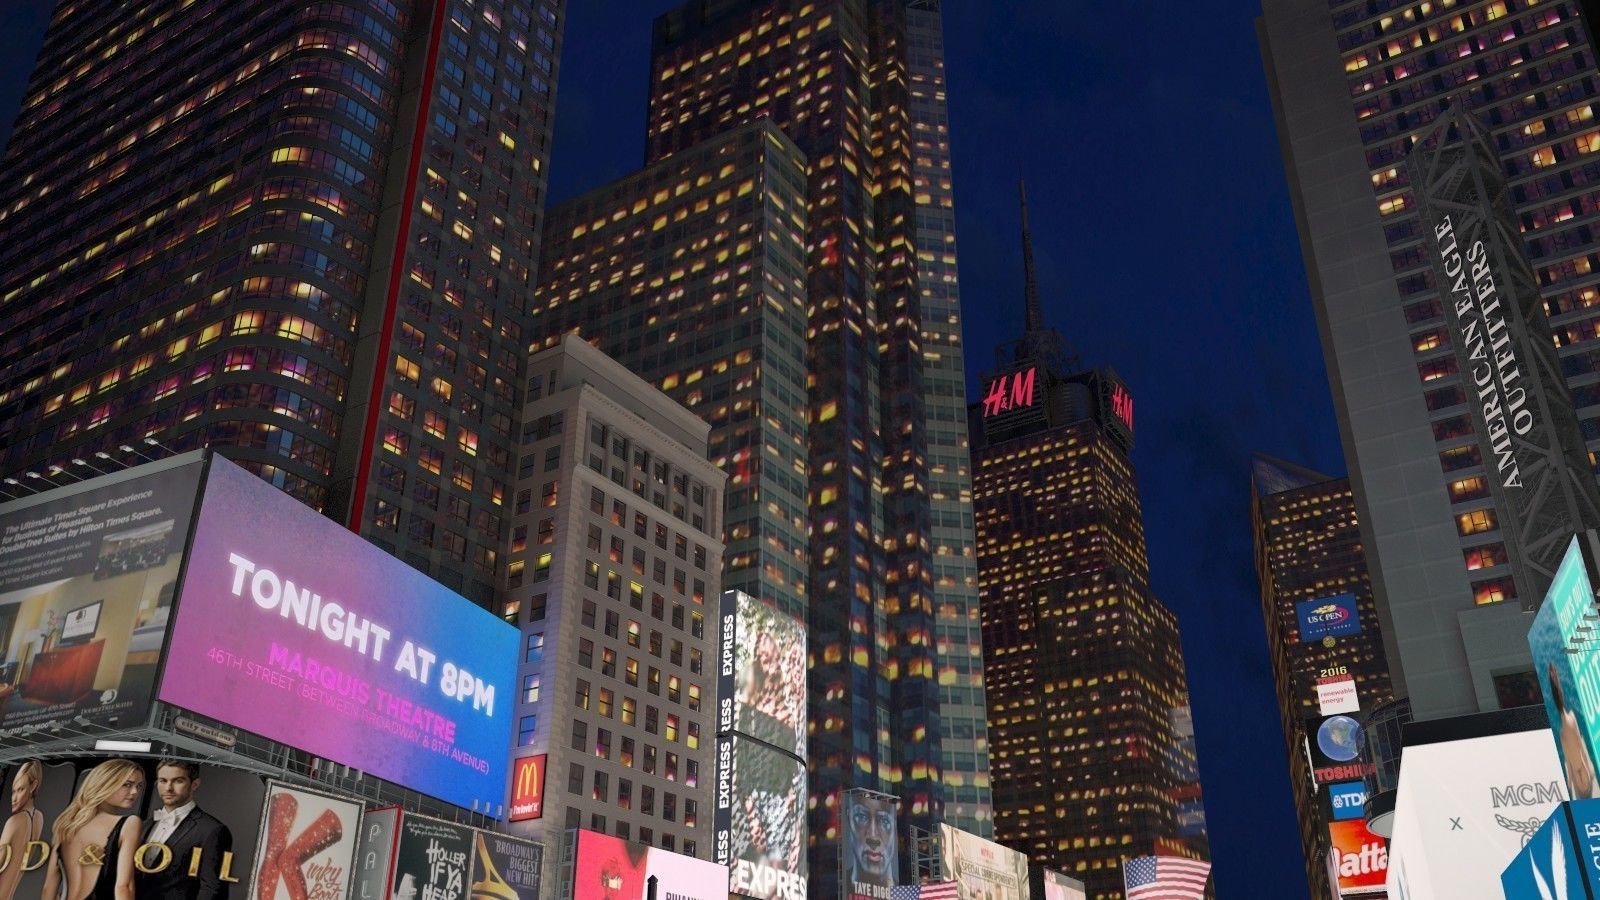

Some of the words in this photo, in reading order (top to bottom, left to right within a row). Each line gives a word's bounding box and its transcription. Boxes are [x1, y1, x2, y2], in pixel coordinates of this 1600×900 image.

[1435, 214, 1475, 319] EAGLE
[1467, 240, 1533, 436] OUTFITTERS
[983, 367, 1036, 418] H&M
[1112, 383, 1133, 433] H&M
[1461, 321, 1523, 489] AMERICAN
[54, 511, 77, 522] Times
[78, 502, 106, 516] Square
[107, 490, 153, 508] Experience
[68, 528, 79, 538] by
[79, 522, 104, 535] Hilton
[106, 515, 130, 528] Times
[131, 507, 162, 521] Square.
[229, 552, 390, 662] TONIGHT
[395, 641, 436, 684] AT
[440, 662, 495, 717] 8PM
[1307, 615, 1319, 623] US
[723, 614, 734, 676] EXPRESS
[1320, 666, 1347, 678] 2016
[268, 642, 369, 705] MARQUIS
[377, 687, 456, 744] THEATRE
[1320, 687, 1354, 697] renewable
[208, 647, 242, 669] 46TH
[246, 661, 294, 692] STREET
[431, 738, 450, 757] 8TH
[451, 747, 490, 775] AVENUE)
[719, 742, 731, 809] EXPRESS
[1315, 763, 1377, 781] TOSHI
[1490, 781, 1564, 808] MCM
[78, 844, 105, 866] &
[134, 841, 240, 883] OIL
[426, 838, 466, 871] HOLLER
[510, 856, 539, 874] BIGGEST
[430, 861, 446, 884] IF
[446, 864, 462, 894] YA
[506, 869, 522, 883] NEW
[854, 881, 871, 896] TAYE
